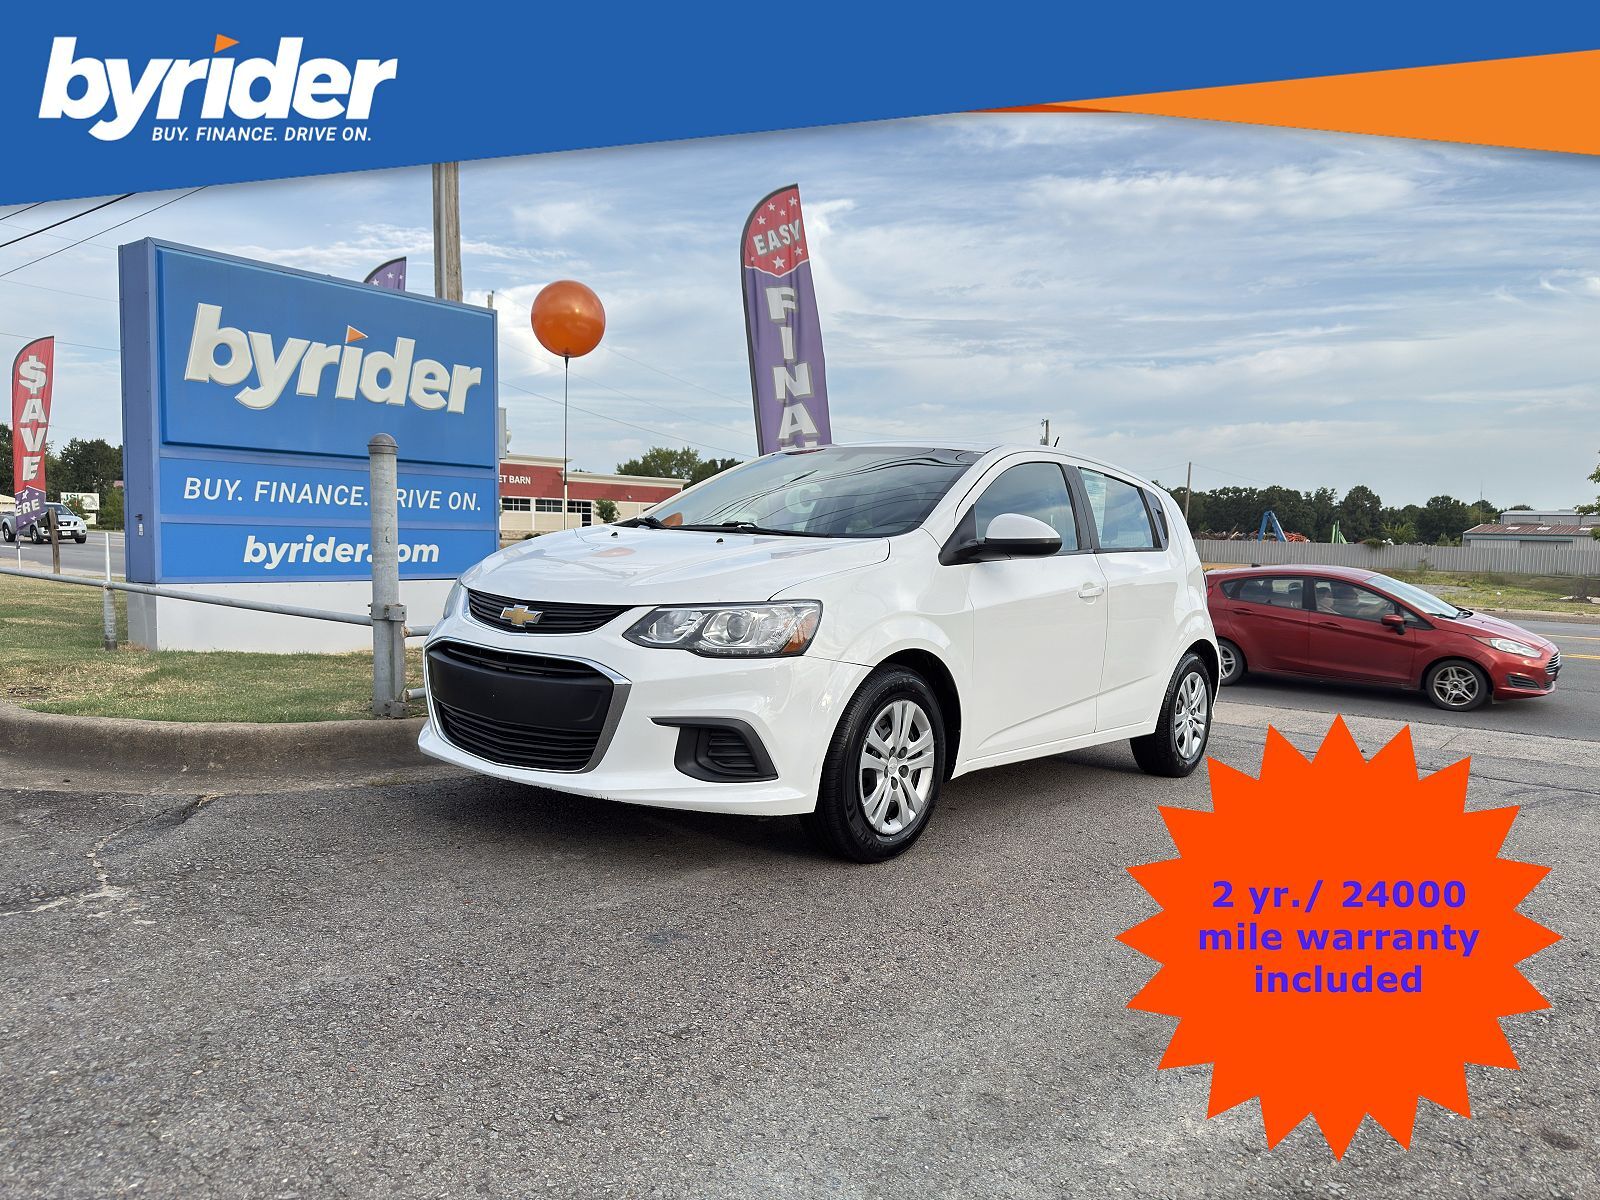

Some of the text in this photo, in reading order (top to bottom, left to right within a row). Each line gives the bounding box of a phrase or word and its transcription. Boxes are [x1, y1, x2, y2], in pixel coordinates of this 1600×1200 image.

[753, 219, 801, 256] EASY
[184, 302, 483, 414] byrider
[183, 477, 481, 511] BUY. FINANCE. RIVE ON.
[509, 475, 531, 484] BARN
[243, 534, 440, 569] byrider.om
